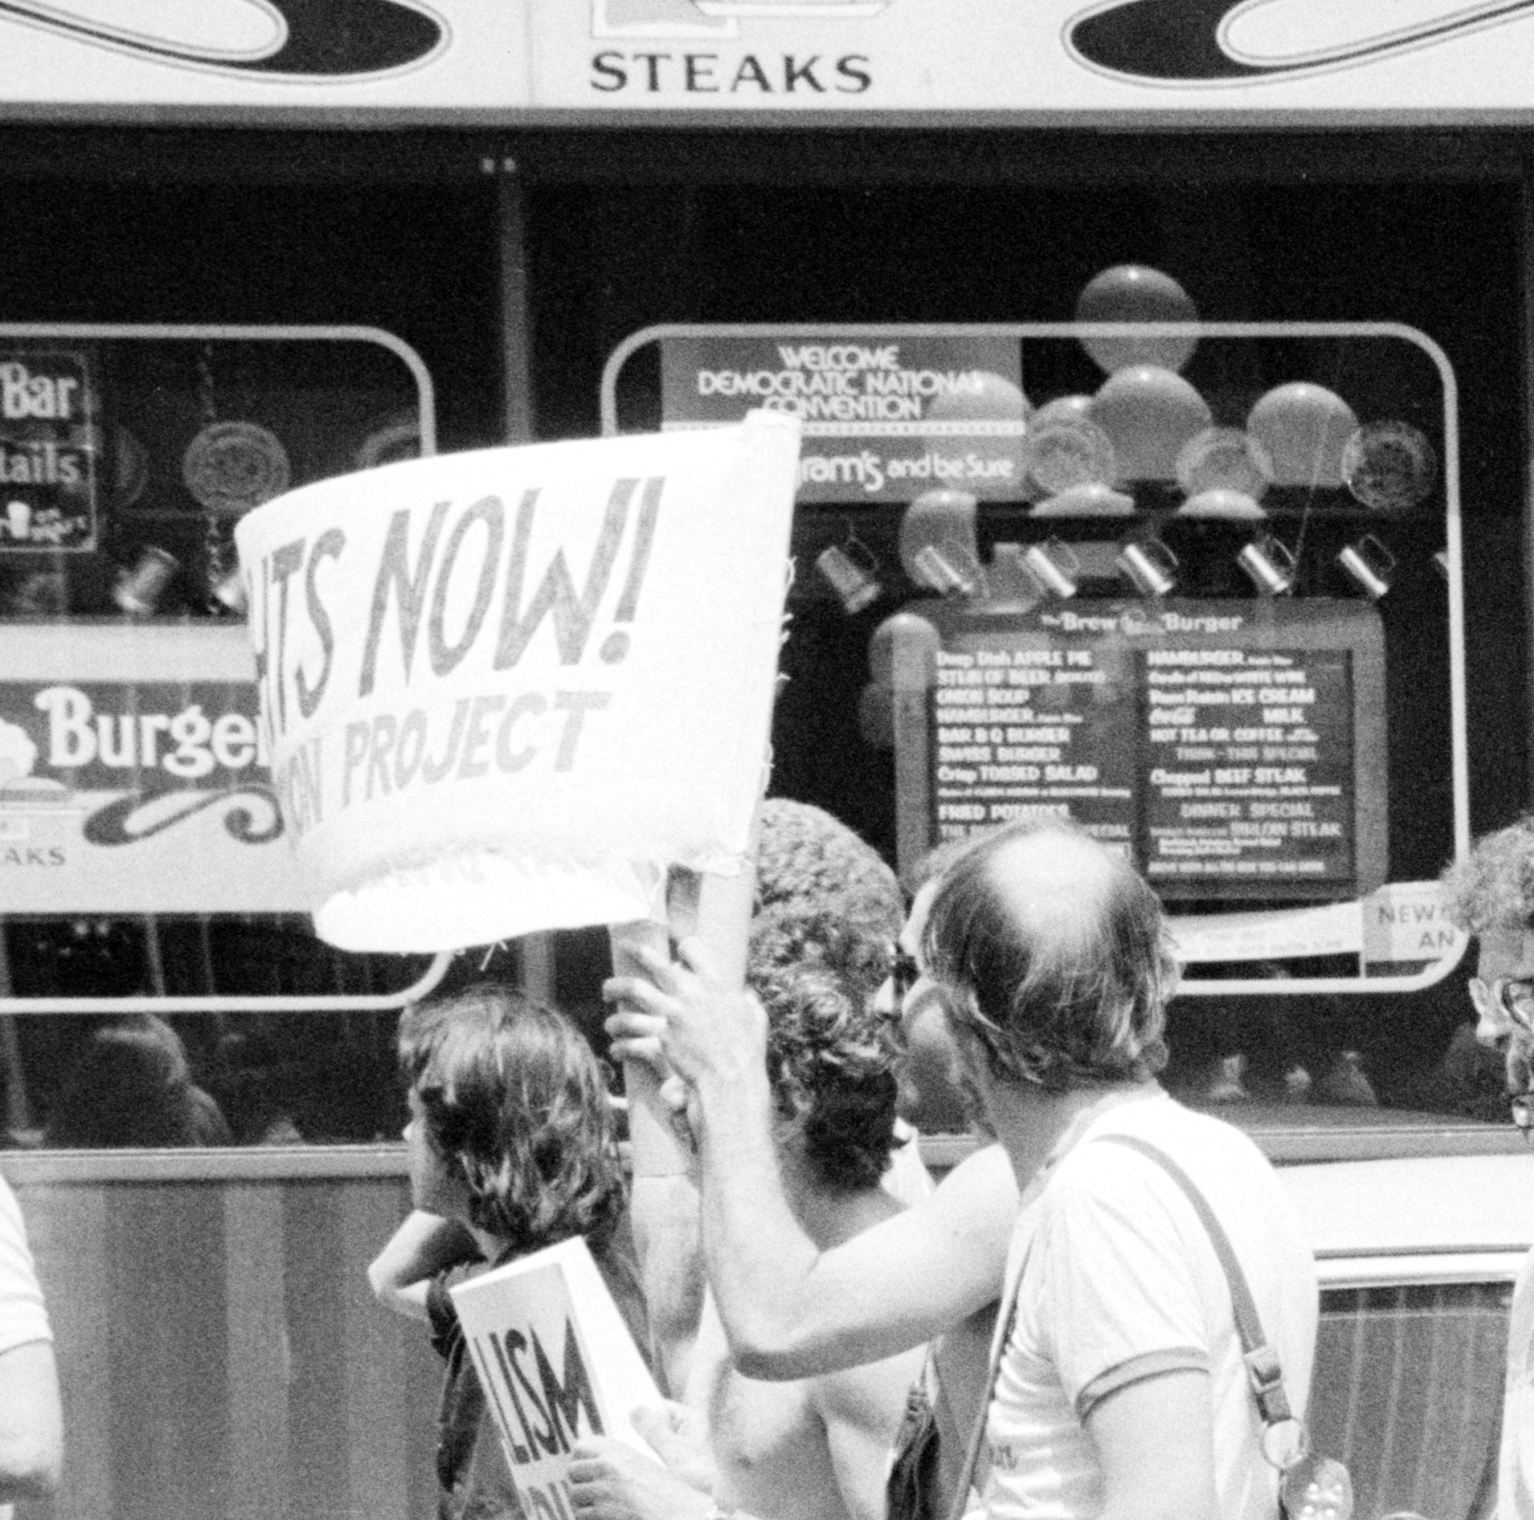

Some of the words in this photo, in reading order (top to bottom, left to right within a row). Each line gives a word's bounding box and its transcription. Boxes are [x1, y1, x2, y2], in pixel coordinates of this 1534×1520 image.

[589, 51, 872, 92] STEAKS
[779, 345, 899, 370] WELCOME
[0, 362, 78, 419] Bar
[698, 370, 859, 395] DEMOCRATIC
[866, 370, 984, 394] NATIONAL
[762, 395, 922, 419] CONVENTION
[887, 453, 932, 478] and
[933, 453, 967, 478] be
[967, 453, 1014, 478] Sure
[359, 477, 665, 698] NOW!
[1061, 612, 1117, 631] Brew
[1161, 612, 1243, 632] Burger
[342, 689, 614, 809] PROJECT
[4, 847, 66, 867] AKS
[1378, 904, 1436, 924] NEW
[473, 1315, 606, 1466] LISM
